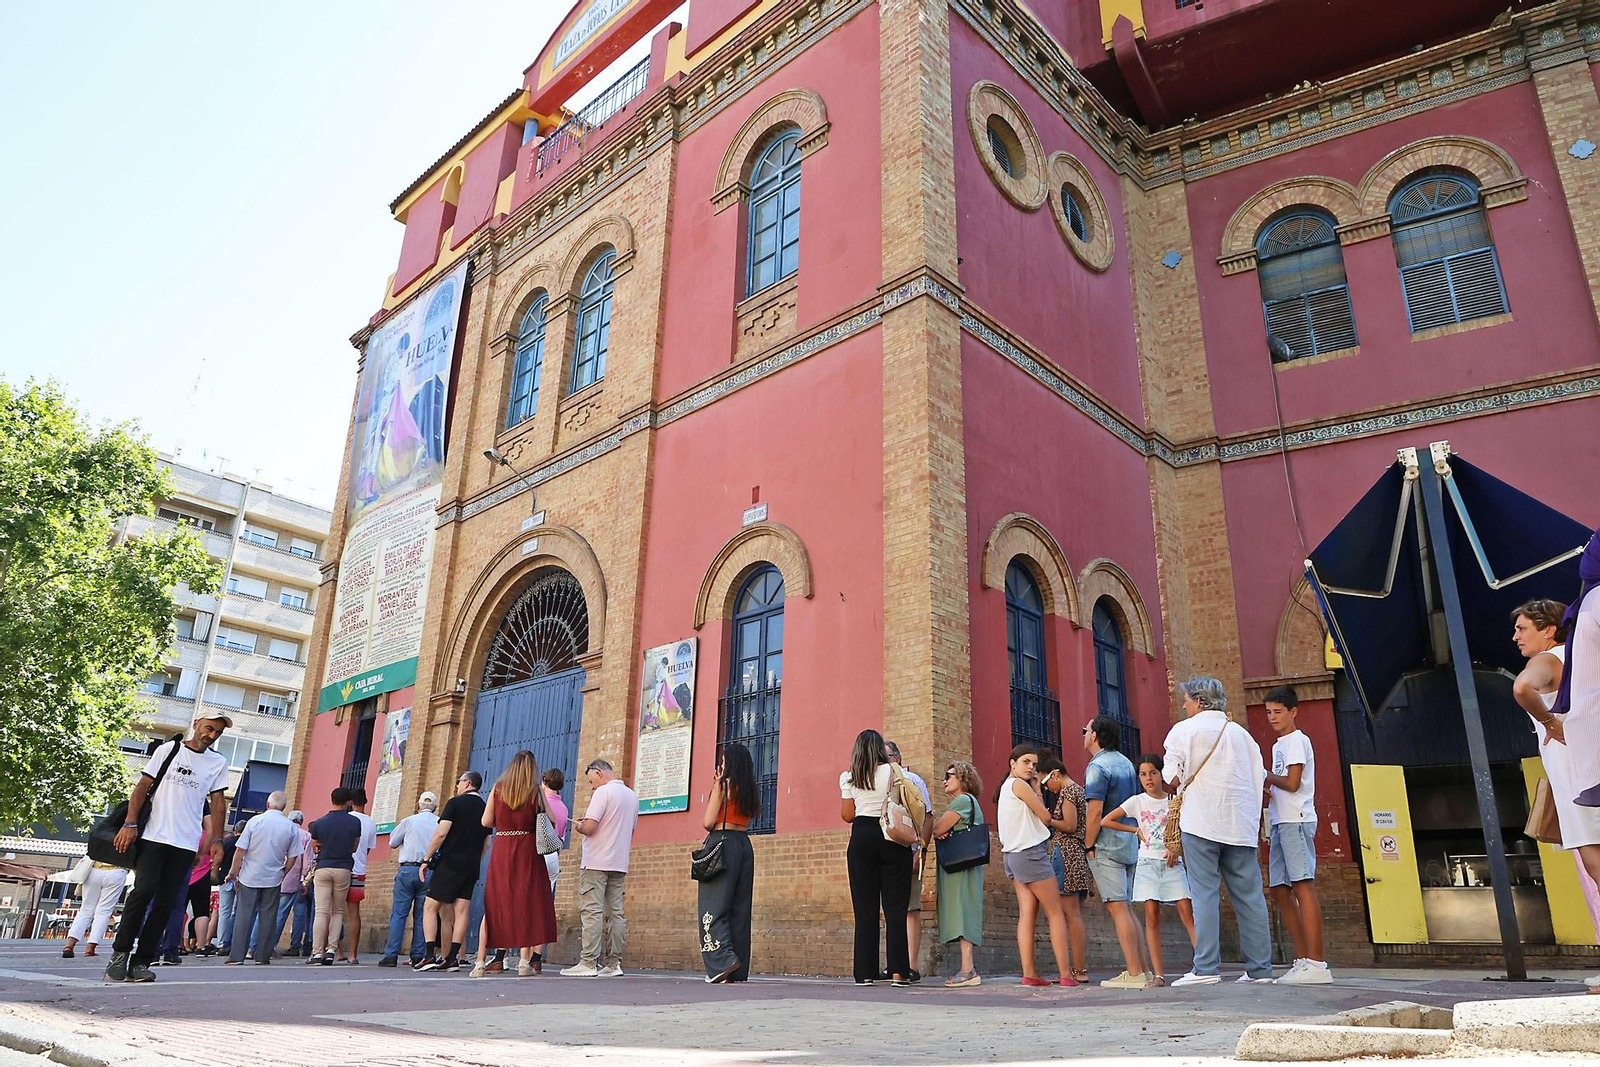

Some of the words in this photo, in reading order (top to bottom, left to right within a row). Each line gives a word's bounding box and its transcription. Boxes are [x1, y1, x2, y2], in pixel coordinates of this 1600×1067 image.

[560, 32, 581, 57] PLAZA
[586, 5, 608, 33] TOROS
[384, 548, 402, 561] EMILIO
[411, 537, 427, 550] JUST
[379, 610, 394, 621] JUAN
[667, 660, 694, 674] HUELVA
